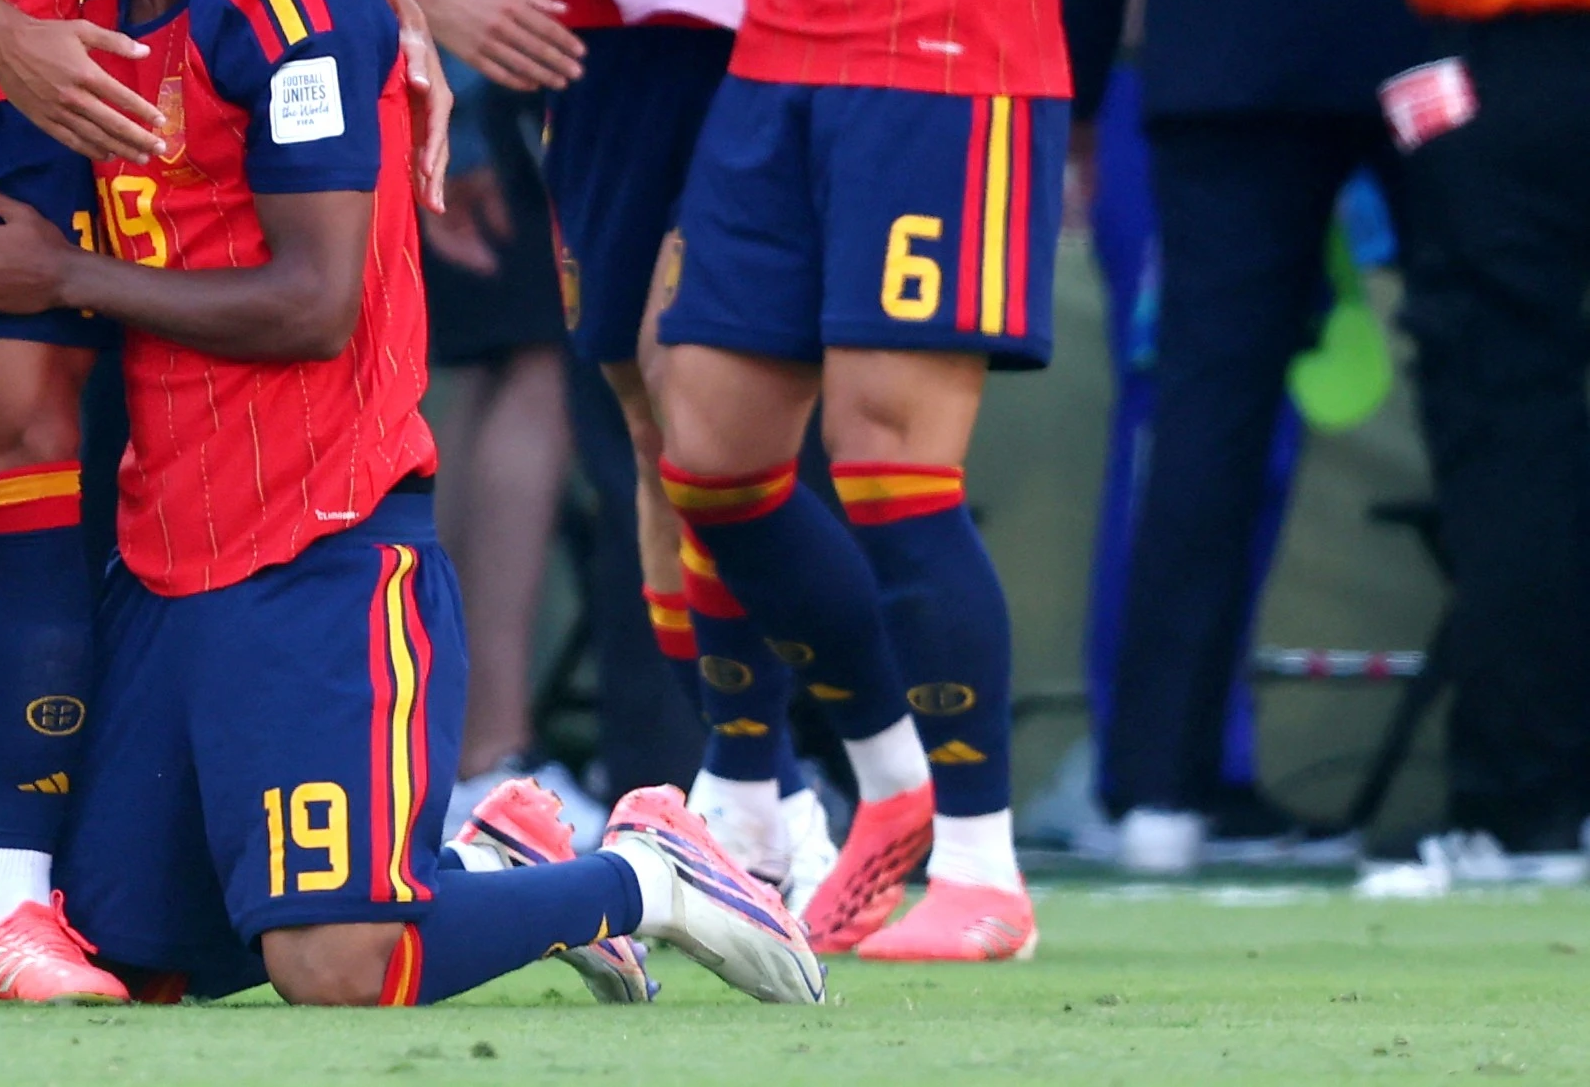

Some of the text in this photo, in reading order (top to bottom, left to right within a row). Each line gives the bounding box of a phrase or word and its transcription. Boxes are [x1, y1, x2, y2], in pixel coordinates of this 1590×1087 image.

[282, 72, 324, 87] FOOTBALL
[283, 84, 326, 104] UNITES
[881, 214, 944, 322] 6
[263, 781, 350, 897] 19
